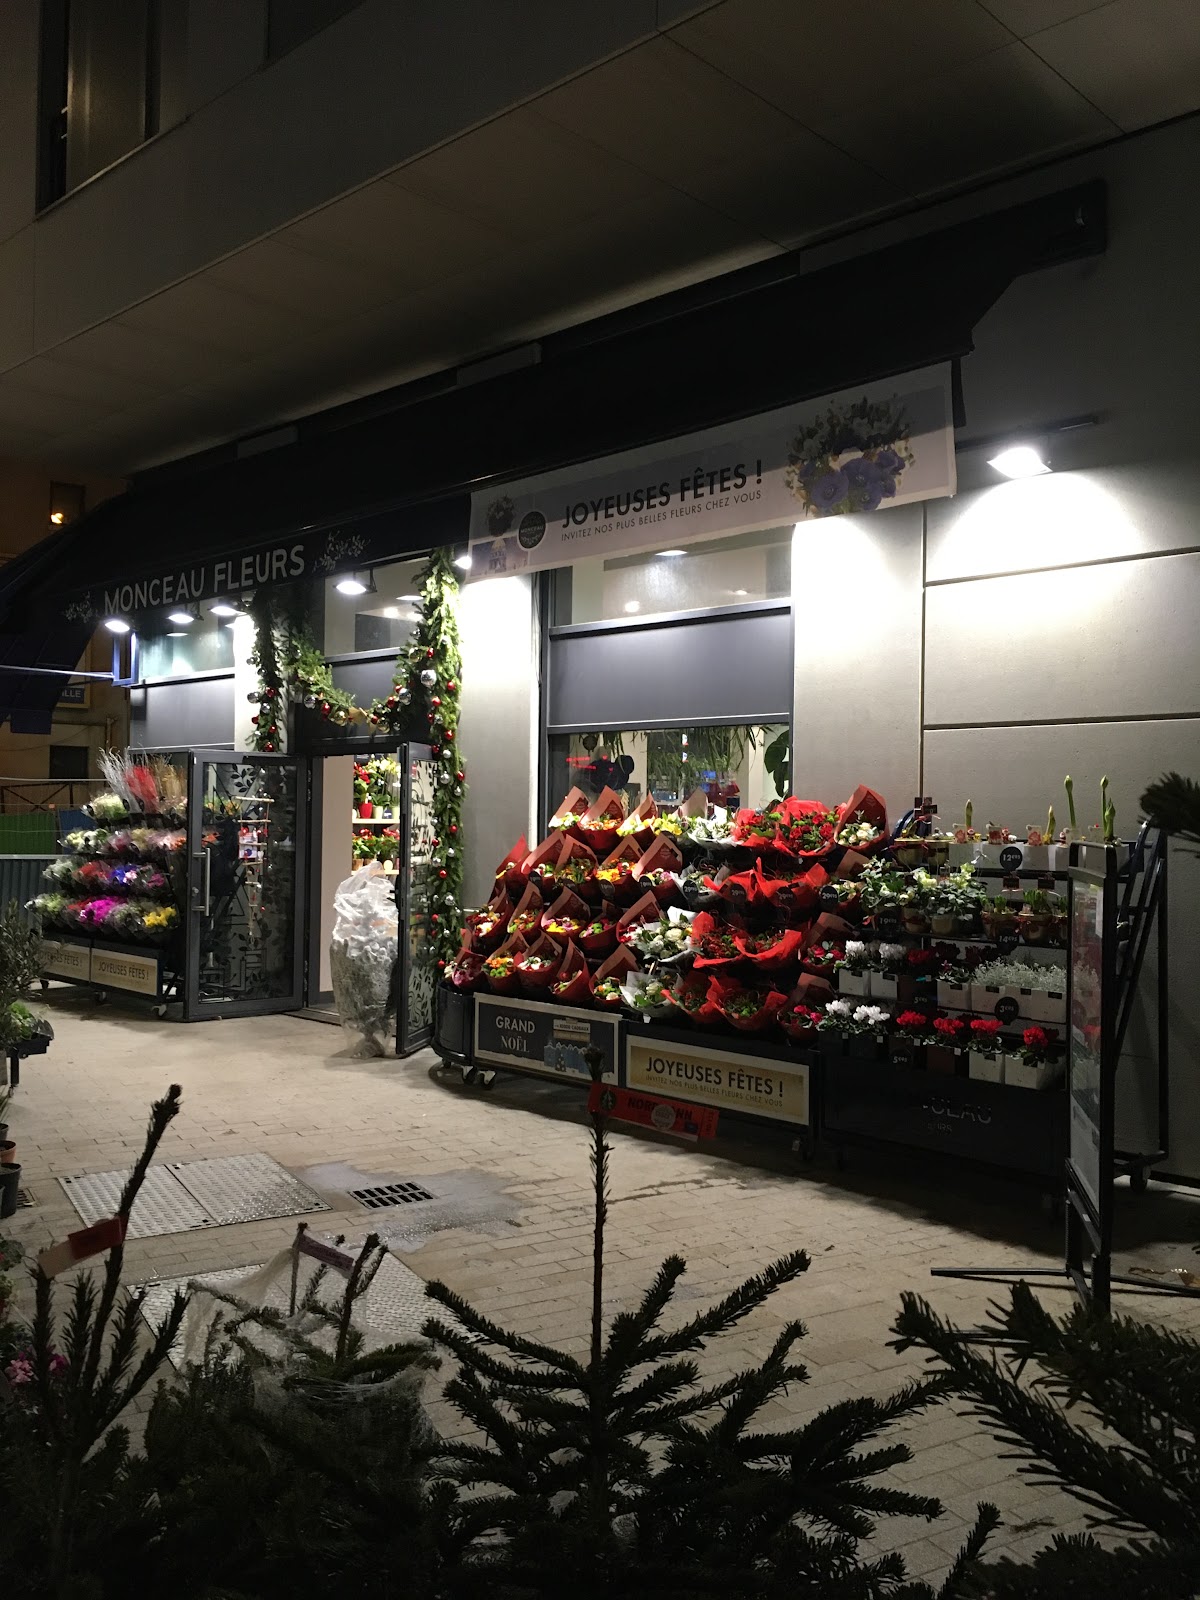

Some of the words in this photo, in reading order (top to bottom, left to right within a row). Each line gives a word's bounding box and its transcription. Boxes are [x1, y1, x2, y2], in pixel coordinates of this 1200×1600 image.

[562, 481, 670, 529] JOYEUSES
[680, 463, 747, 502] FÊTES
[561, 526, 592, 542] INVITEZ
[595, 522, 613, 534] NOS
[616, 517, 636, 531] PLUS
[639, 511, 668, 526] BELLES
[670, 503, 702, 520] FLEURS
[706, 497, 730, 511] CHEZ
[734, 490, 762, 504] VOUS
[104, 566, 205, 617] MONCEAU
[214, 545, 305, 593] FLEURS
[98, 959, 128, 977] JOYEUSES
[128, 964, 146, 980] FÊTES
[495, 1016, 536, 1034] GRAND
[501, 1035, 530, 1053] NOËL
[645, 1075, 668, 1085] INVITEZ
[669, 1080, 683, 1088] NOS
[684, 1082, 698, 1090] PLUS
[700, 1084, 720, 1095] BELLES
[721, 1090, 743, 1100] FLEURS
[745, 1093, 762, 1103] CHEZ
[764, 1099, 783, 1108] VOUS
[646, 1057, 722, 1085] JOYEUSES
[729, 1068, 774, 1096] FÊTES
